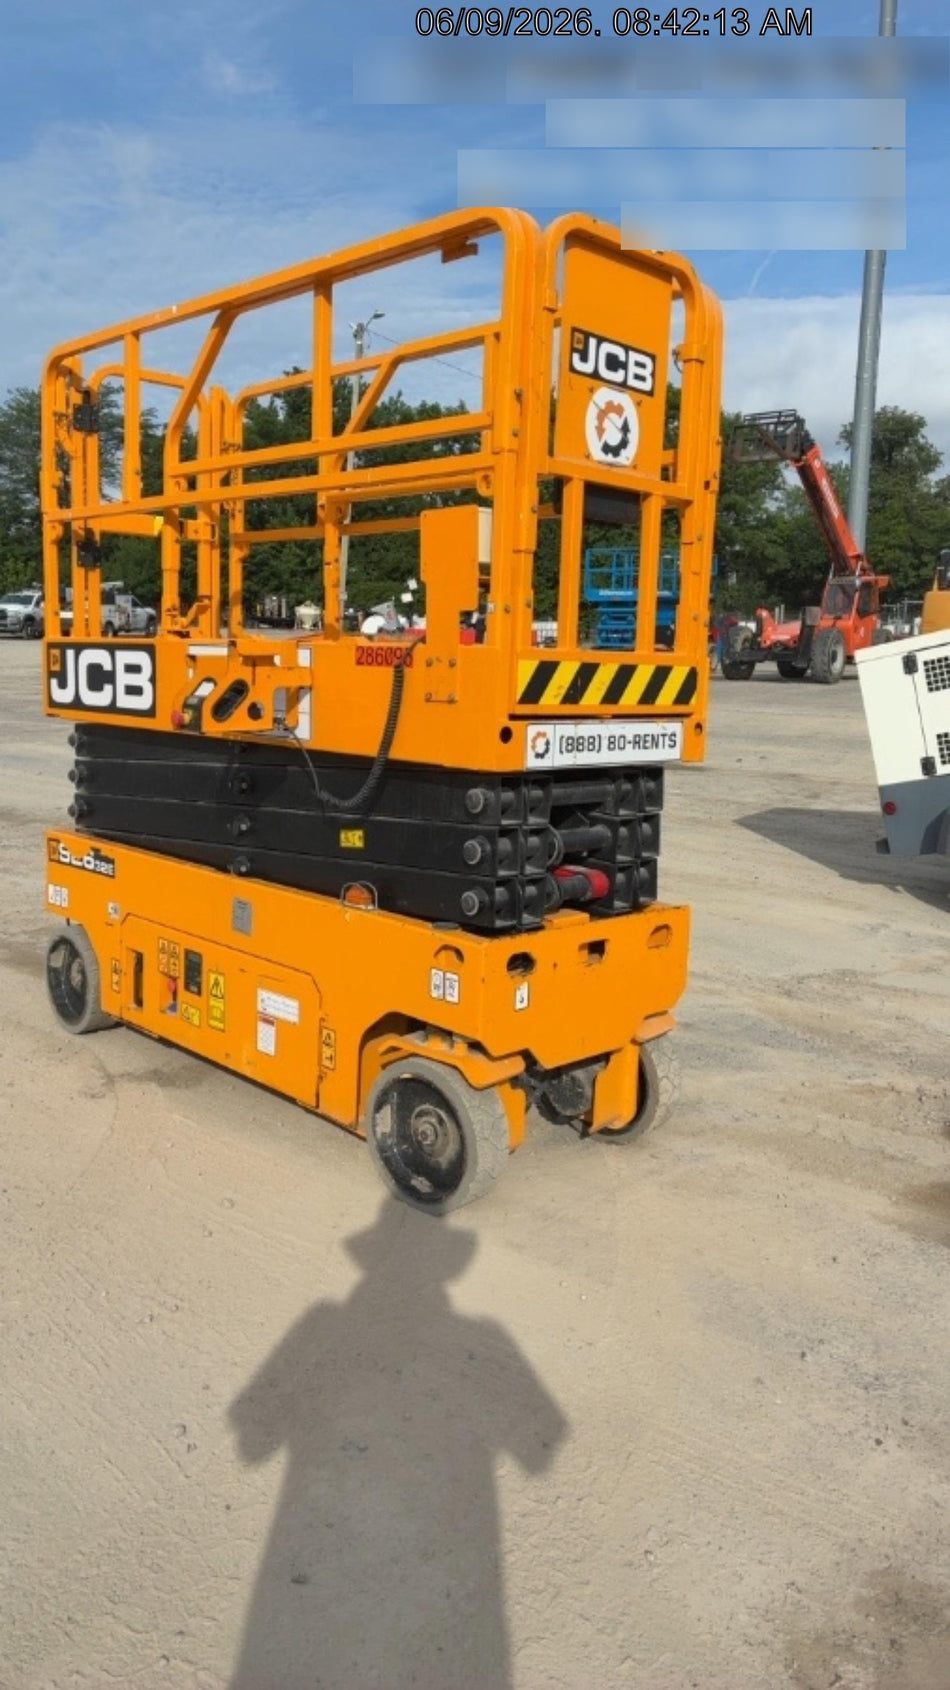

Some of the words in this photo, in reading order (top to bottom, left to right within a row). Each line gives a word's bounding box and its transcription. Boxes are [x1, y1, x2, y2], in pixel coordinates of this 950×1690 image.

[572, 335, 654, 392] JCB
[50, 648, 154, 711] JCB
[559, 734, 602, 755] (888)
[607, 731, 677, 751] 80-RENTS
